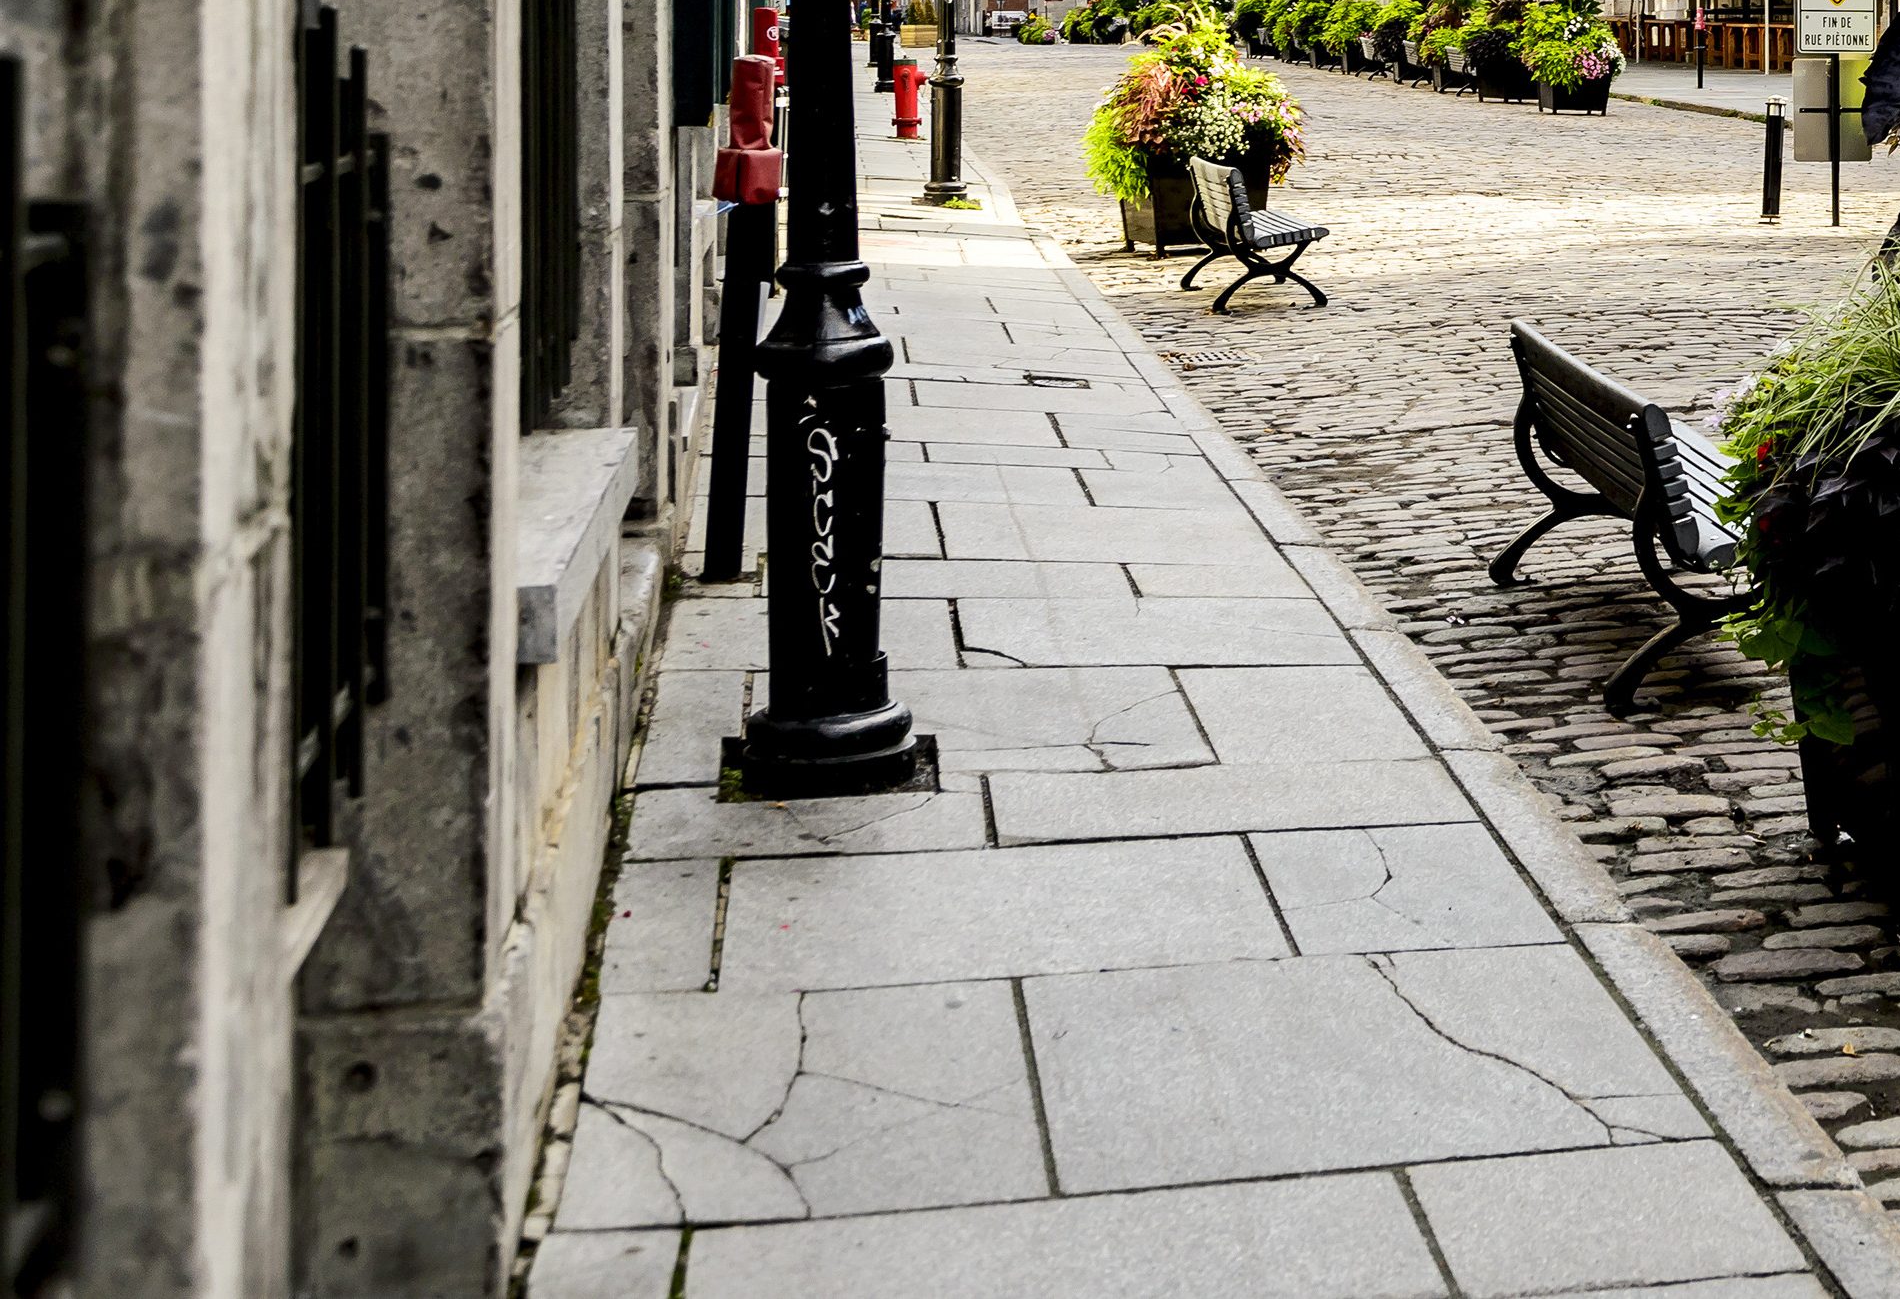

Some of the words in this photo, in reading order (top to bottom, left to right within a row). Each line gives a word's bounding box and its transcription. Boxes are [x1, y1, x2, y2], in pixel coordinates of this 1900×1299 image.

[1823, 16, 1837, 28] FIN
[1841, 16, 1852, 29] DE
[1805, 33, 1822, 46] RUE
